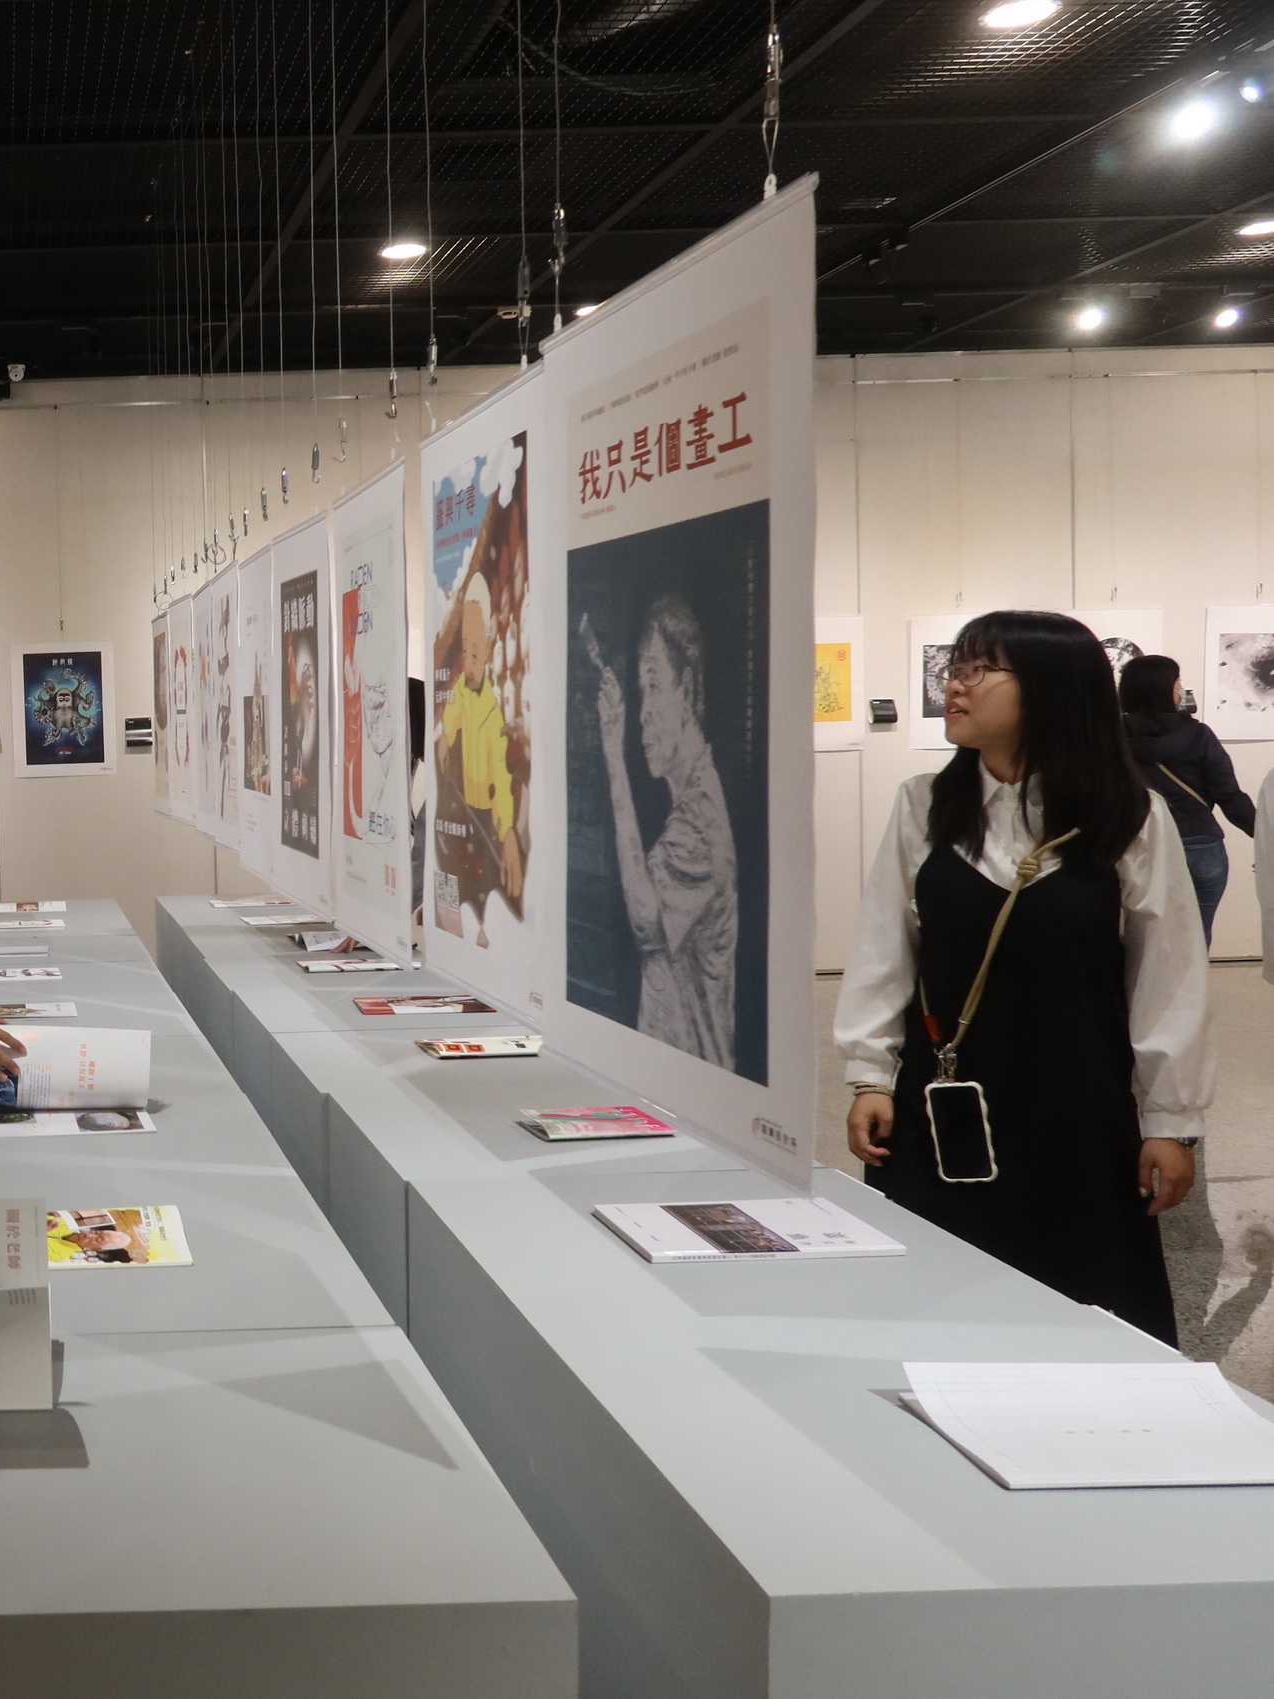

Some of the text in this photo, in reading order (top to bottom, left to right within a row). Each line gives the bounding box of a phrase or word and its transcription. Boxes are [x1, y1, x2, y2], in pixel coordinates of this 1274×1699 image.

[578, 391, 753, 505] 我只是個畫工
